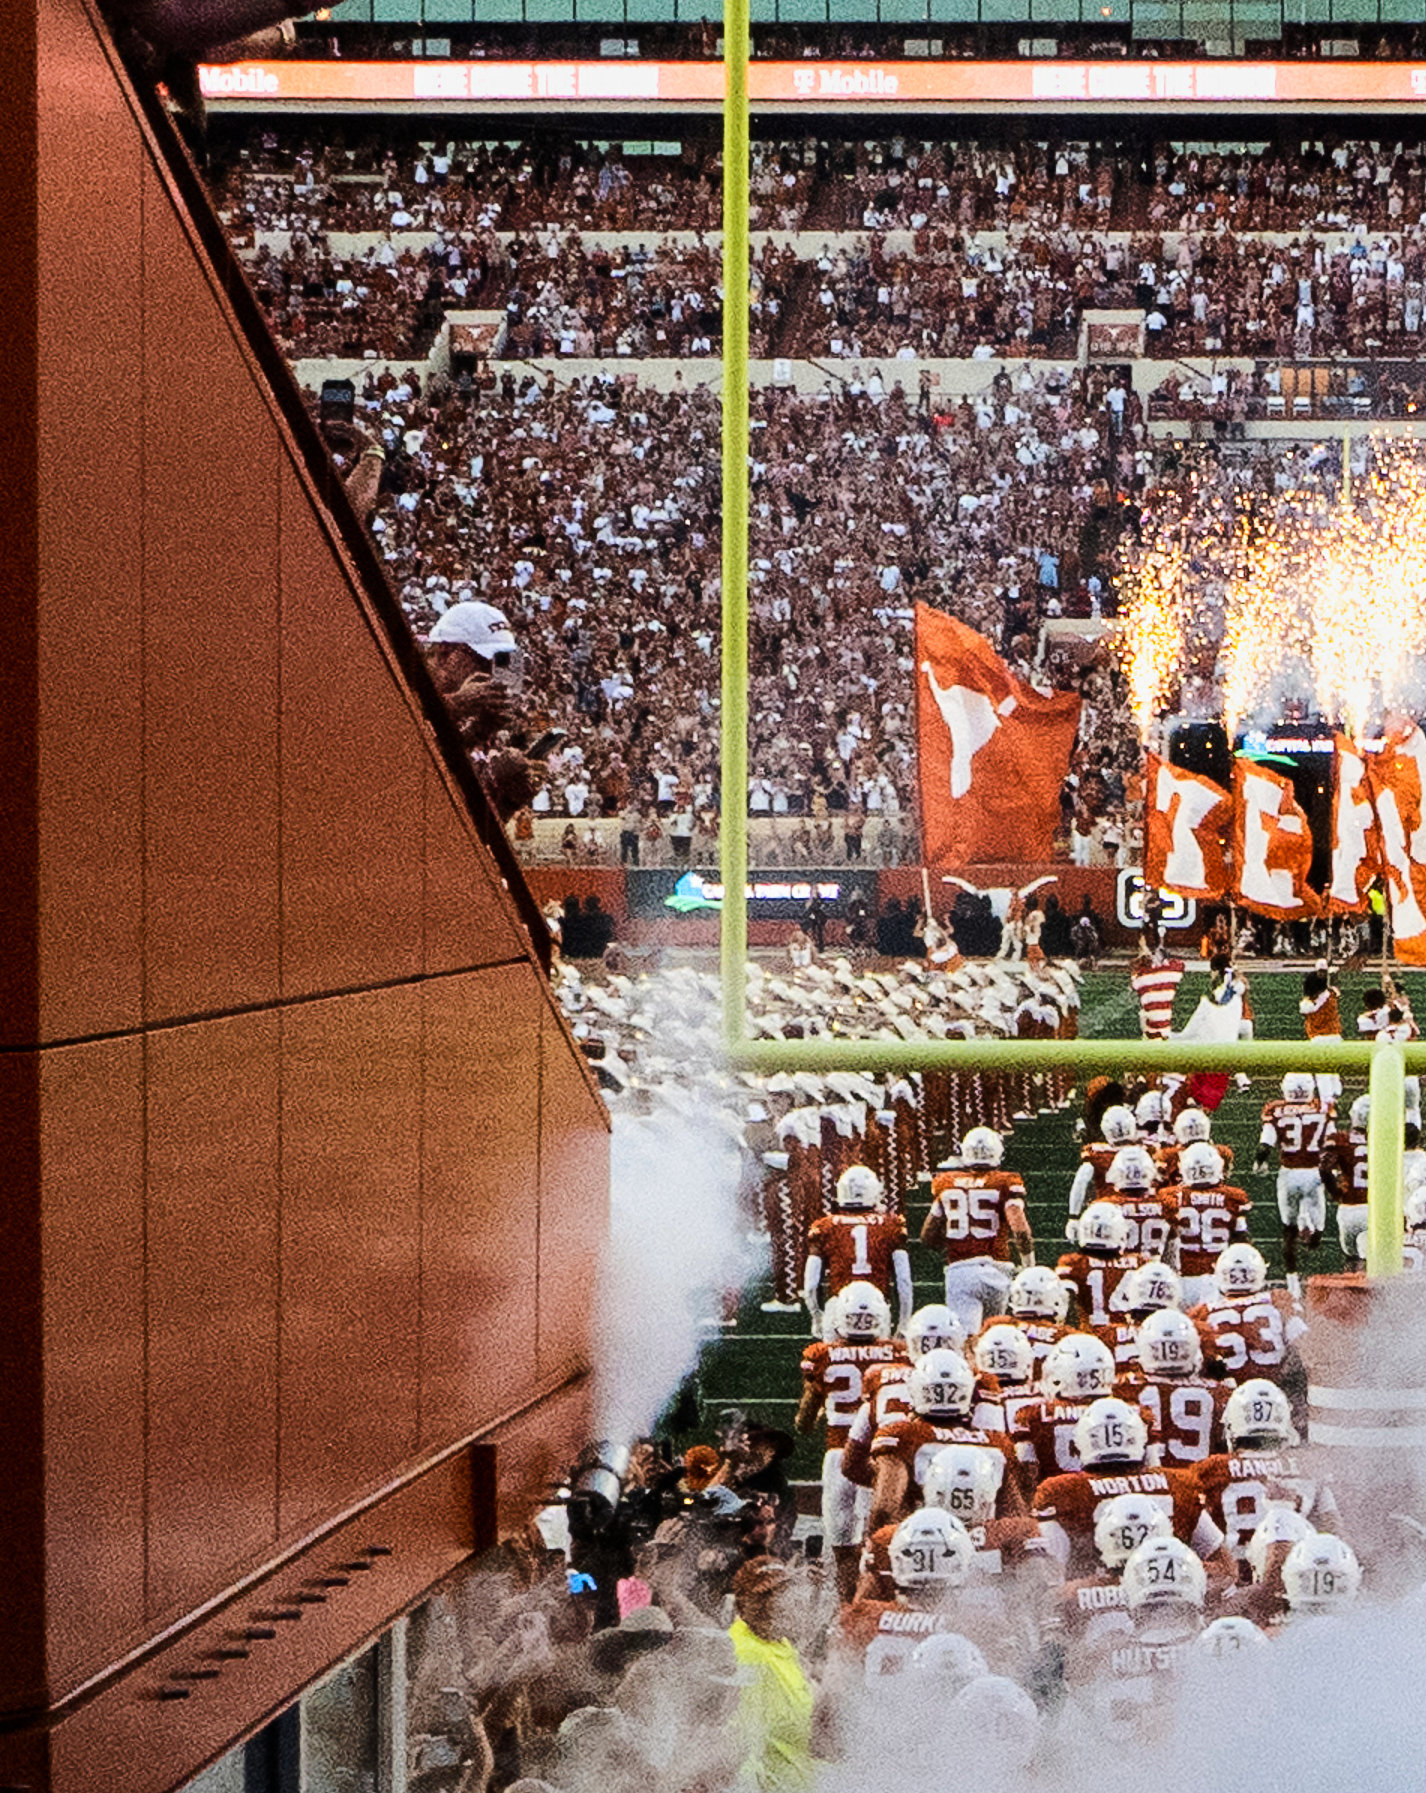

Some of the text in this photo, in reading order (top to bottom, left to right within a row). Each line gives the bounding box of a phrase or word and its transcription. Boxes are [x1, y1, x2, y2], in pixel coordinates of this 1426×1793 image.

[199, 67, 279, 92] Mobile
[819, 69, 898, 94] Mobile
[1277, 1113, 1328, 1153] 37
[940, 1188, 1000, 1240] 85
[851, 1225, 873, 1275] 1
[828, 1345, 894, 1362] WATKINS
[1253, 1401, 1273, 1422] 87
[1104, 1422, 1124, 1448] 15
[1138, 1386, 1215, 1463] 19
[1088, 1473, 1169, 1495] NORTON
[950, 1487, 975, 1511] 65
[1148, 1558, 1175, 1584] 54
[1313, 1570, 1335, 1595] 19
